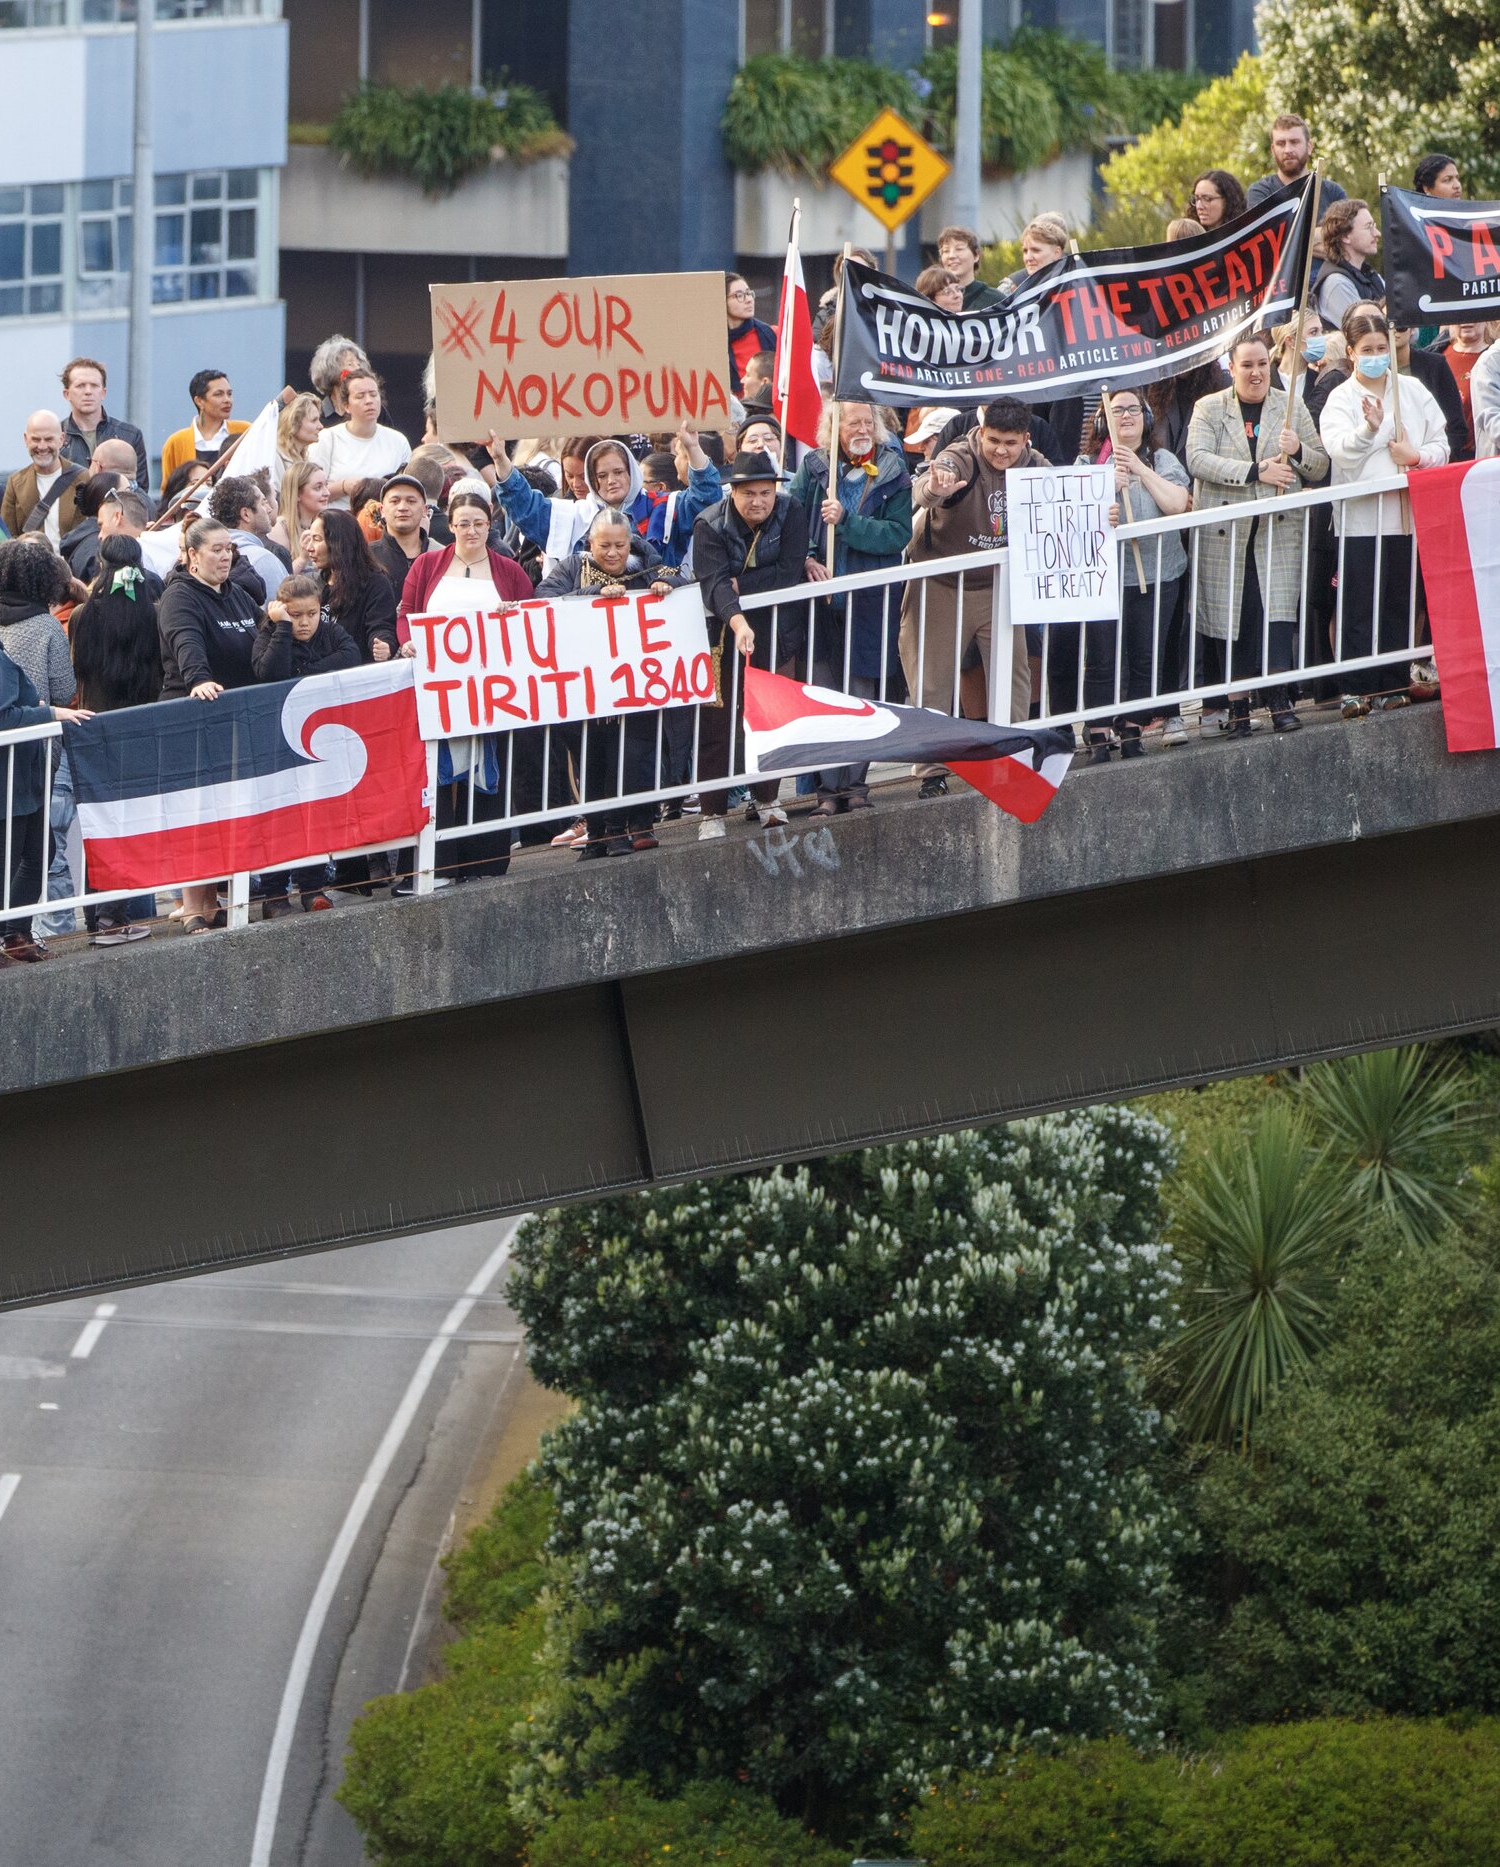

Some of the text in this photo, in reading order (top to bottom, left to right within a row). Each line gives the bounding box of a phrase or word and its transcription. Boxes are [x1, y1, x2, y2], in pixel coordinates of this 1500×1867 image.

[539, 286, 645, 360] OUR
[876, 220, 1288, 365] HONOUR THE TREATY
[880, 361, 914, 380] READ
[916, 367, 972, 385] ARTICLE
[975, 367, 1004, 383] ONE
[1017, 358, 1055, 378] READ
[1059, 346, 1119, 370] ARTICLE
[1121, 340, 1153, 360] TWO
[1164, 325, 1199, 349] READ
[1202, 299, 1251, 335] ARTICLE
[473, 363, 729, 422] MOKOPUNA
[1020, 500, 1102, 535] TE TIRITI
[1024, 530, 1108, 571] HONOUR
[1024, 569, 1107, 600] THE TREATY
[411, 593, 672, 673] TOITŪ TE
[423, 652, 716, 734] TIRITI 1840
